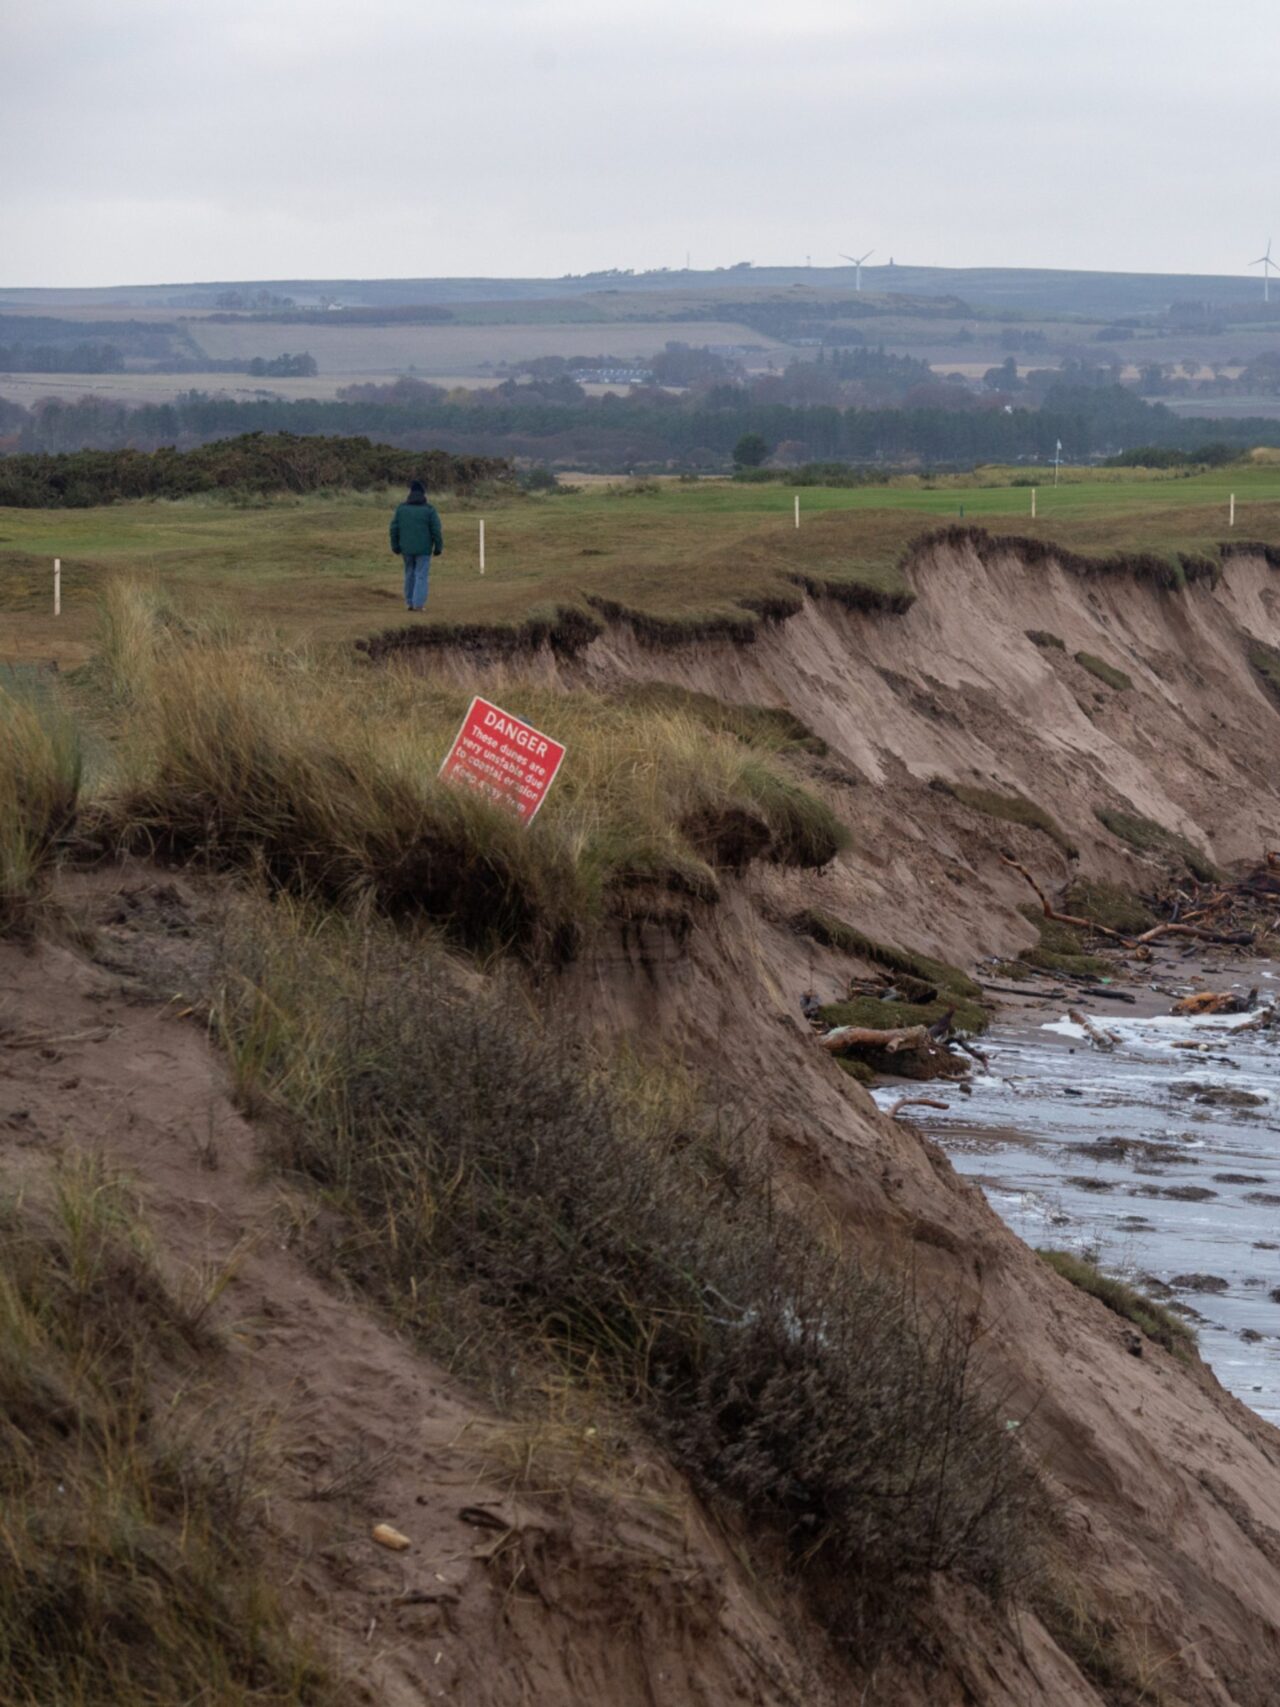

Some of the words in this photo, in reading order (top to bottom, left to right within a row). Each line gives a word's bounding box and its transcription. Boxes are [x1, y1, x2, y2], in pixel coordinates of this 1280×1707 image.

[471, 725, 498, 748] These
[500, 744, 528, 765] dunes
[529, 763, 545, 776] are
[484, 711, 548, 758] DANGER
[456, 747, 466, 758] to
[468, 757, 502, 781] coastal
[504, 777, 538, 800] ersion
[462, 738, 482, 754] very
[484, 750, 524, 778] unstable
[525, 774, 543, 789] due
